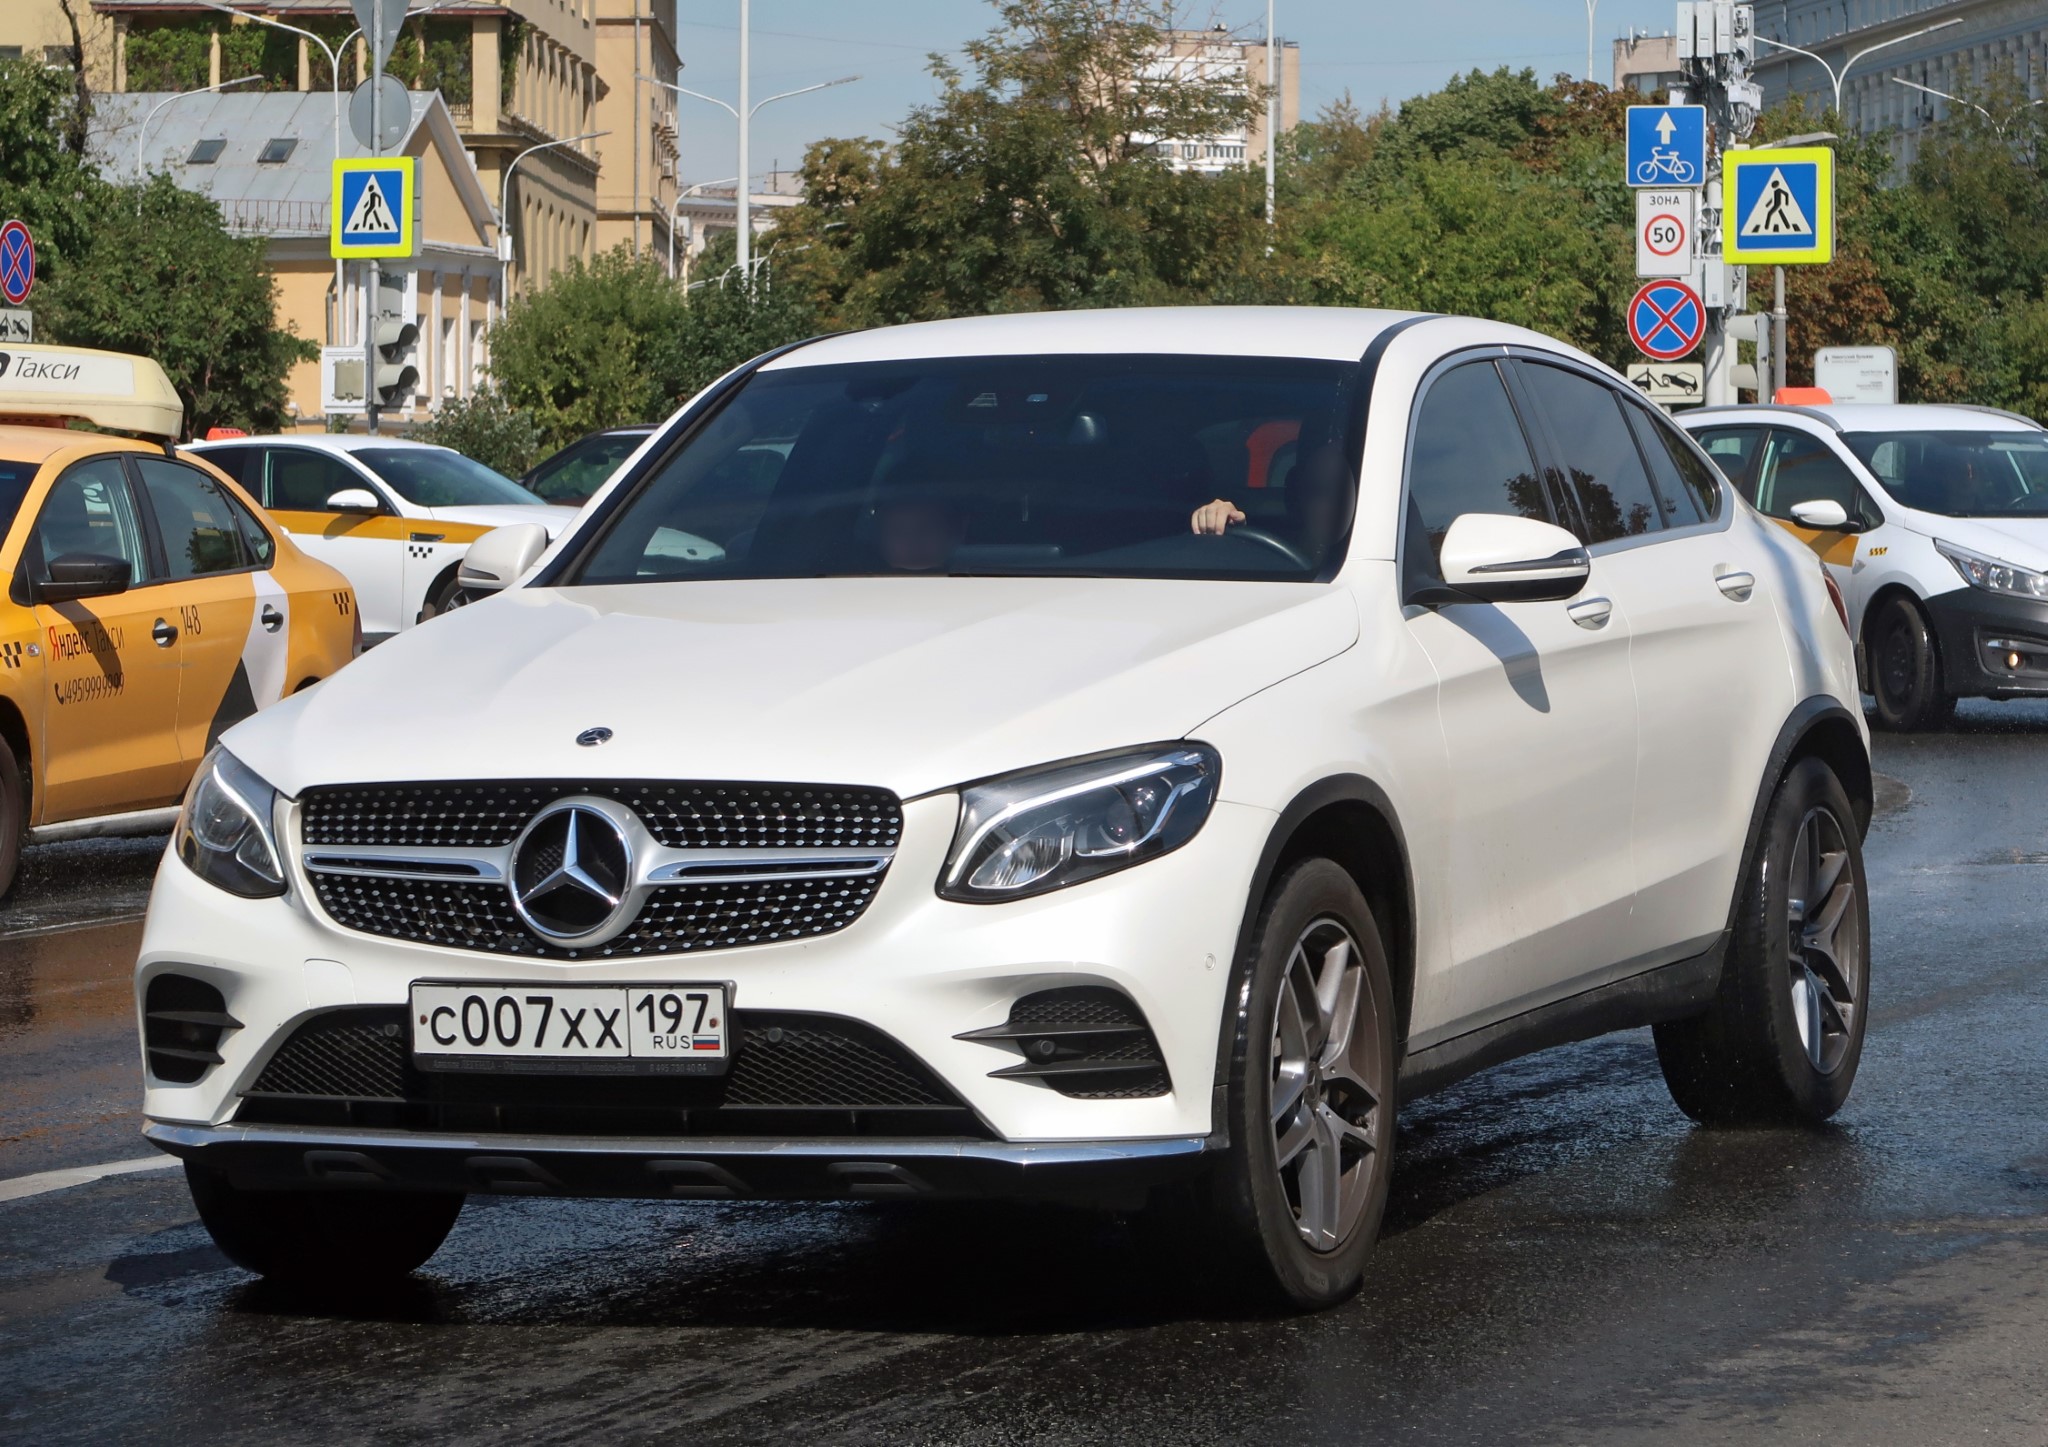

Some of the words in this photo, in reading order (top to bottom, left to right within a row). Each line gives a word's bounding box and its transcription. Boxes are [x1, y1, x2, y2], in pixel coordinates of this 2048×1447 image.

[1649, 195, 1681, 206] ЗОНА
[1653, 226, 1676, 244] 50
[15, 356, 81, 380] Такси
[180, 604, 202, 636] 148
[48, 625, 93, 662] Яндекс
[91, 621, 125, 653] Такси
[635, 992, 710, 1035] 197
[652, 1035, 691, 1050] RUS
